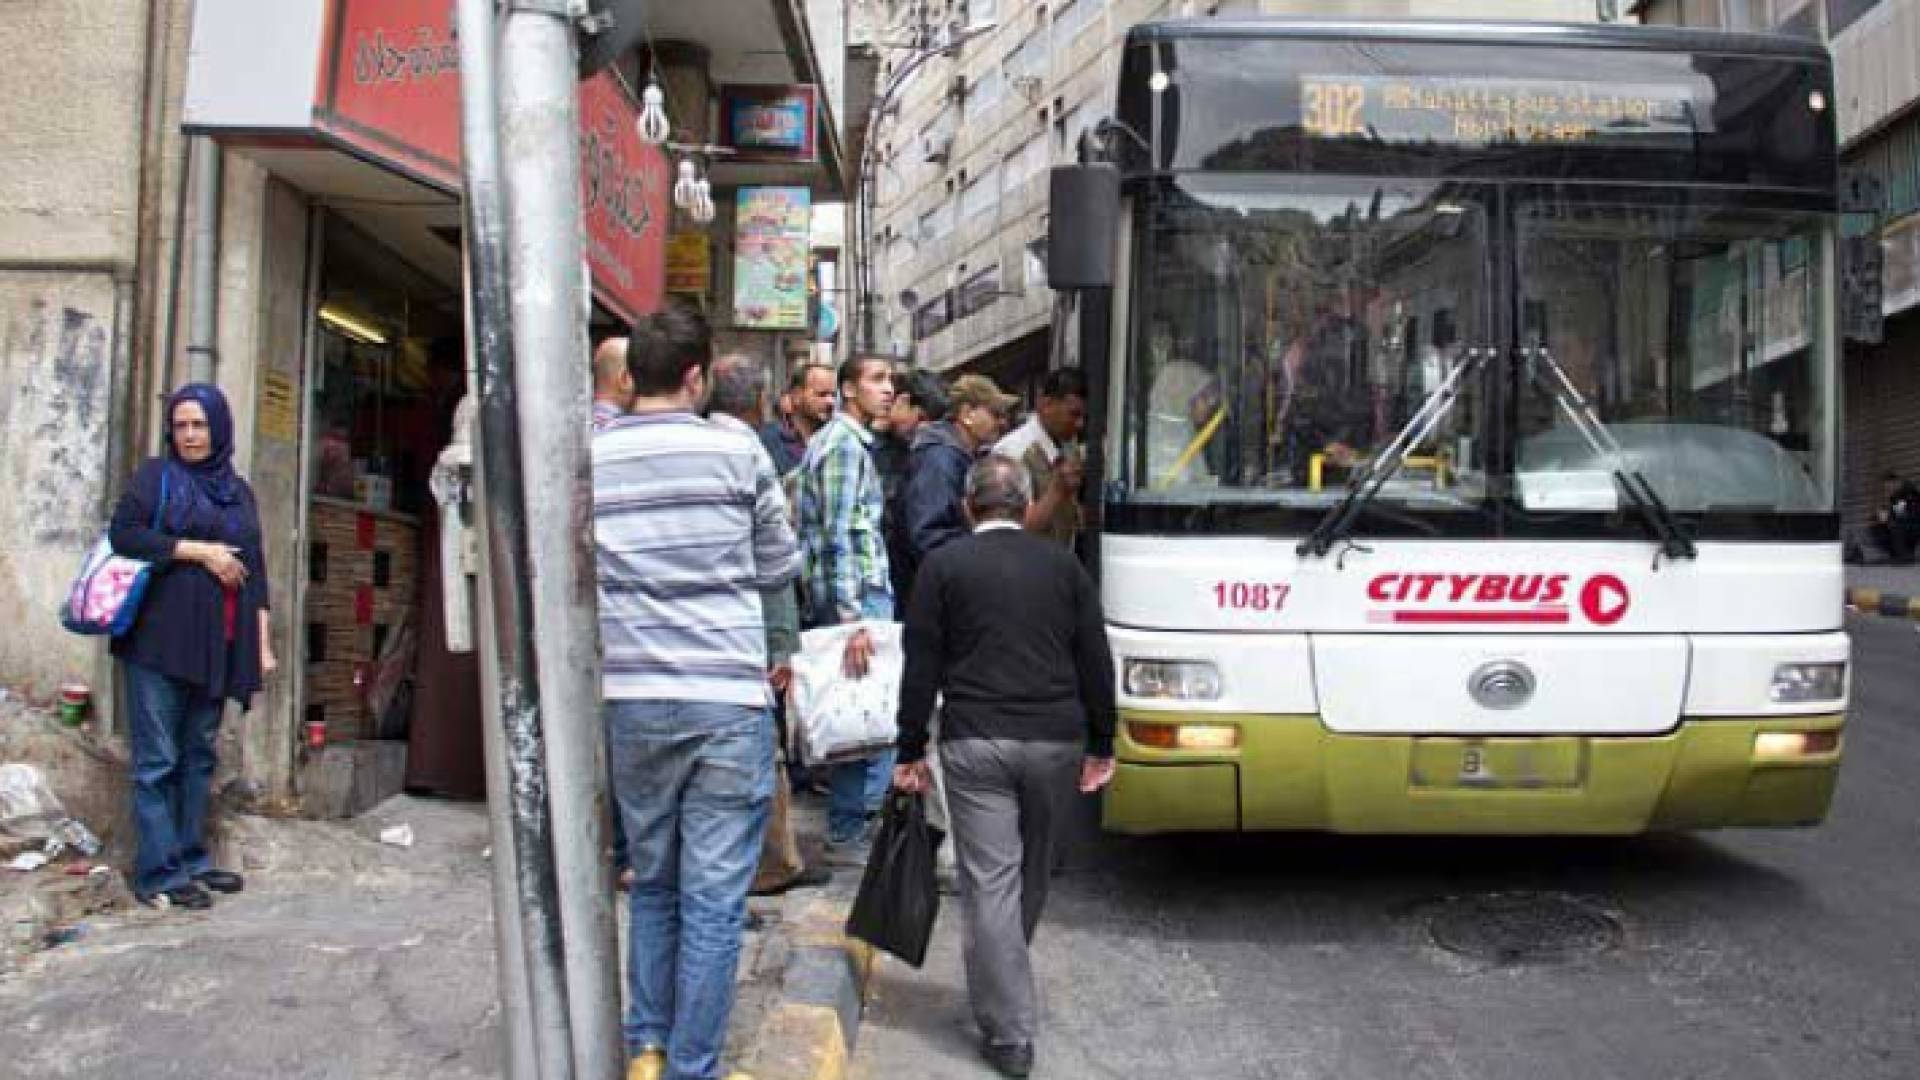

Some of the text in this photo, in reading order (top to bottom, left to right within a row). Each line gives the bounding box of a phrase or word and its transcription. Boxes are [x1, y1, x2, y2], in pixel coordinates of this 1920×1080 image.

[1303, 82, 1364, 134] 302
[1212, 581, 1292, 611] 1087
[1366, 572, 1571, 604] CITYBUS
